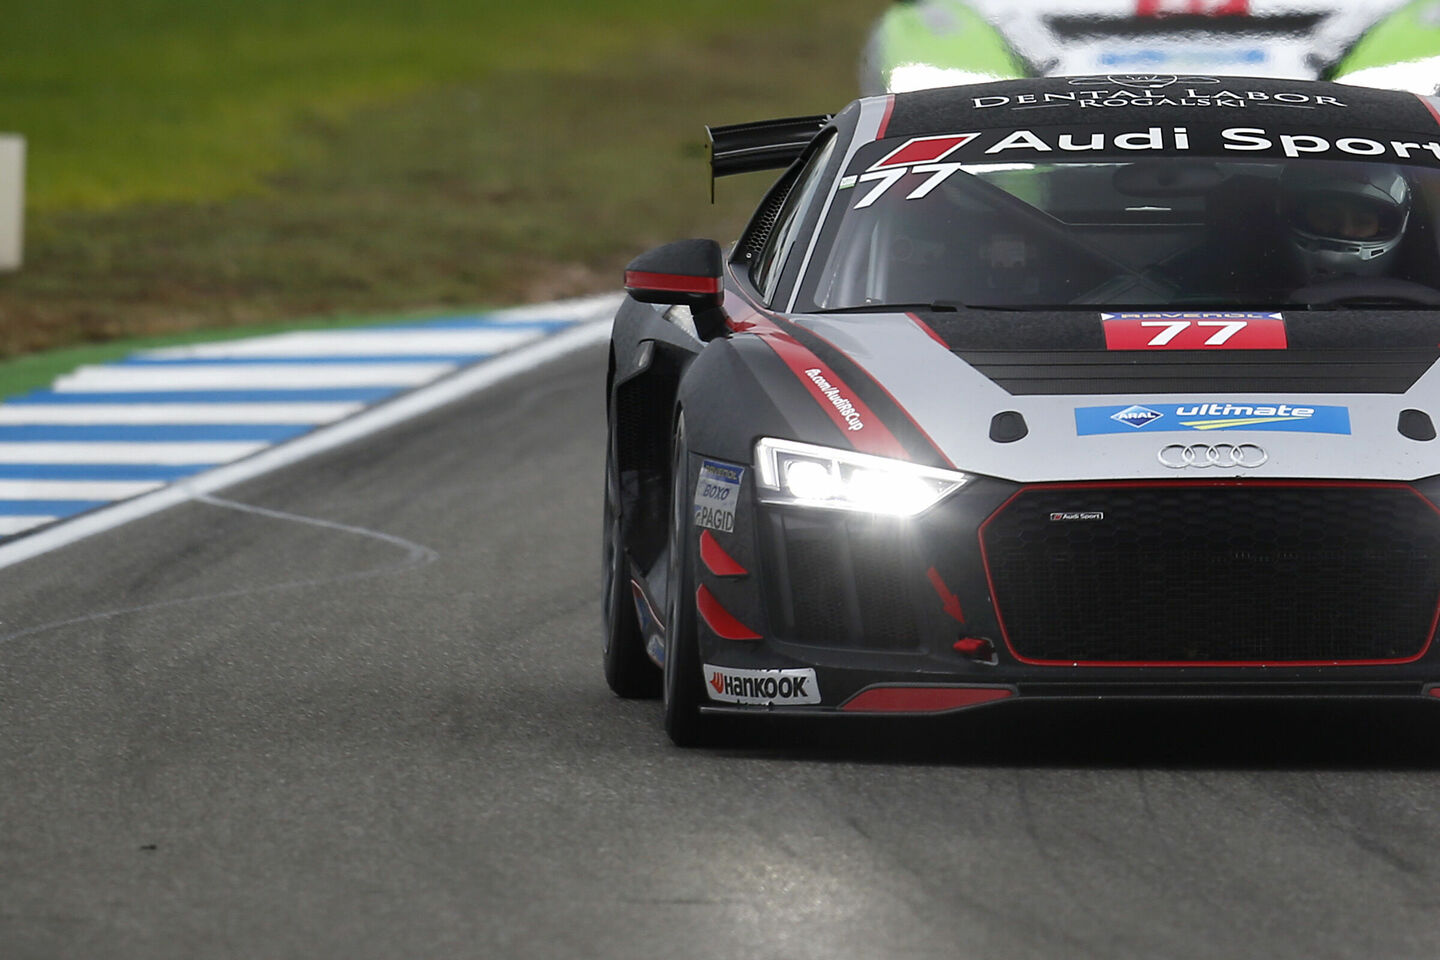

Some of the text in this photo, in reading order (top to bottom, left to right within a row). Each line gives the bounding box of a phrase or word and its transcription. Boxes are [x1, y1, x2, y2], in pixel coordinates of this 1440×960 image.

[972, 88, 1348, 110] DENTAL LABOR
[1079, 98, 1247, 109] ROGALSKI
[984, 126, 1190, 155] Audi
[853, 162, 961, 210] 77
[1141, 321, 1248, 346] 77
[1118, 403, 1315, 420] ARAL ultimate
[702, 483, 730, 501] BOXO
[700, 506, 735, 531] PAGID
